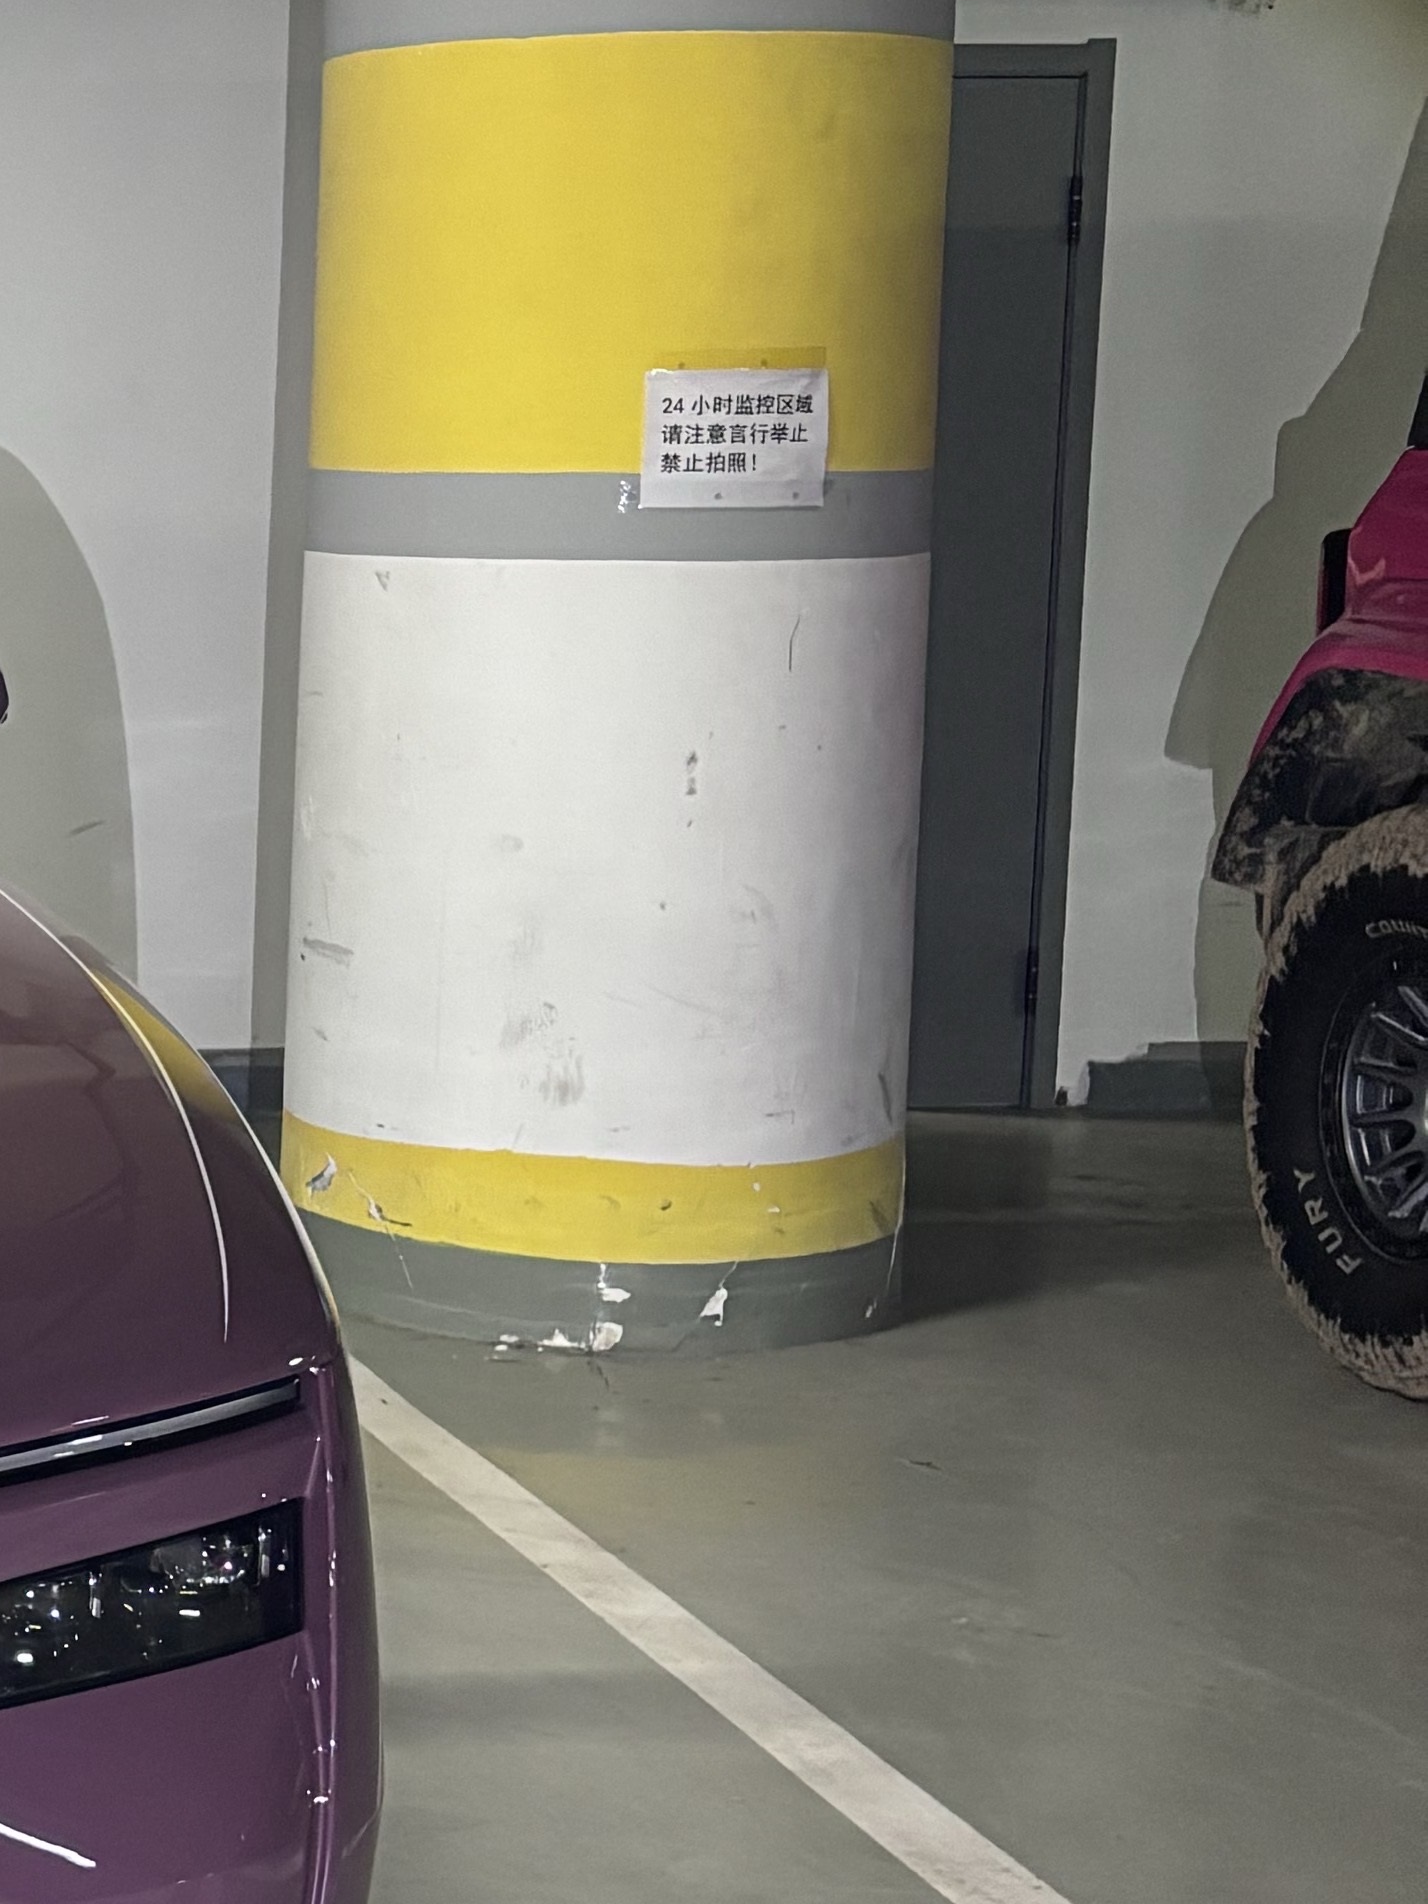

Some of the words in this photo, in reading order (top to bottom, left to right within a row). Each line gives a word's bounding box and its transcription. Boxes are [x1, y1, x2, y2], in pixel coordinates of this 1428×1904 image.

[661, 397, 685, 415] 24
[691, 394, 814, 416] 小时监控区域
[661, 423, 809, 445] 请注意言行举止
[1293, 1169, 1363, 1275] FURY
